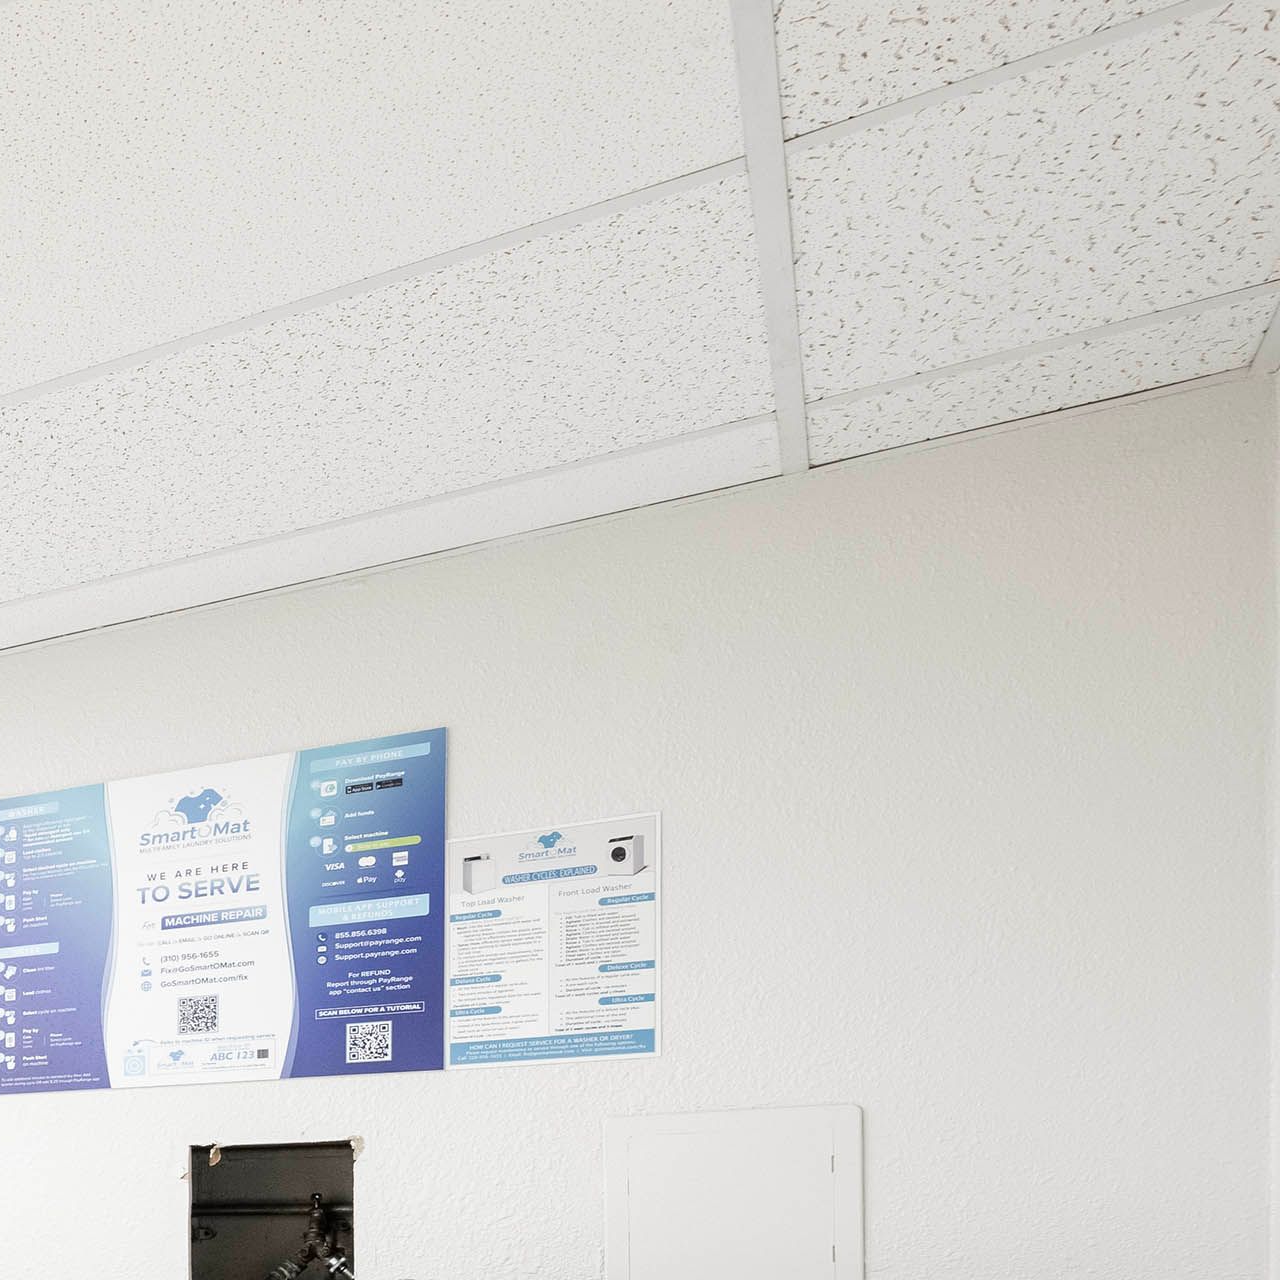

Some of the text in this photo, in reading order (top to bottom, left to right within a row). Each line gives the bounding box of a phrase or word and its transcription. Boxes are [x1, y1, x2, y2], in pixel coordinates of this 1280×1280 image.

[336, 757, 352, 767] PAY
[370, 750, 403, 762] PHONE
[182, 840, 213, 849] LAUNDRY
[214, 834, 252, 844] SOLUTIONS
[147, 861, 248, 881] WE ARE HERE
[325, 862, 344, 871] VISA
[363, 876, 377, 884] Pay
[503, 872, 530, 884] WASHER
[560, 865, 596, 877] EXPLAINED
[137, 873, 260, 904] TO SERVE
[558, 883, 632, 897] Front Load Washer
[461, 894, 525, 909] Top Load Washer
[607, 893, 648, 904] Regular Cycle
[318, 898, 419, 914] MOBILE APP SUPPORT
[165, 912, 218, 927] MACHINE
[221, 908, 263, 921] REPAIR
[351, 910, 393, 920] REFUNDS
[455, 911, 493, 921] Regular Cycle
[334, 936, 422, 949] Support@payrange.com
[160, 950, 220, 964] (310) 956-1655
[334, 948, 417, 961] Support.payrange.com
[160, 960, 255, 974] Fix@GoSmartOMat.com
[360, 969, 391, 977] REFUND
[607, 962, 647, 971] Deluxe Cycle
[160, 974, 248, 988] GoSmartOMat.com/fix
[378, 976, 413, 984] PayRange
[385, 983, 410, 991] section
[210, 1050, 255, 1061] ABC 123
